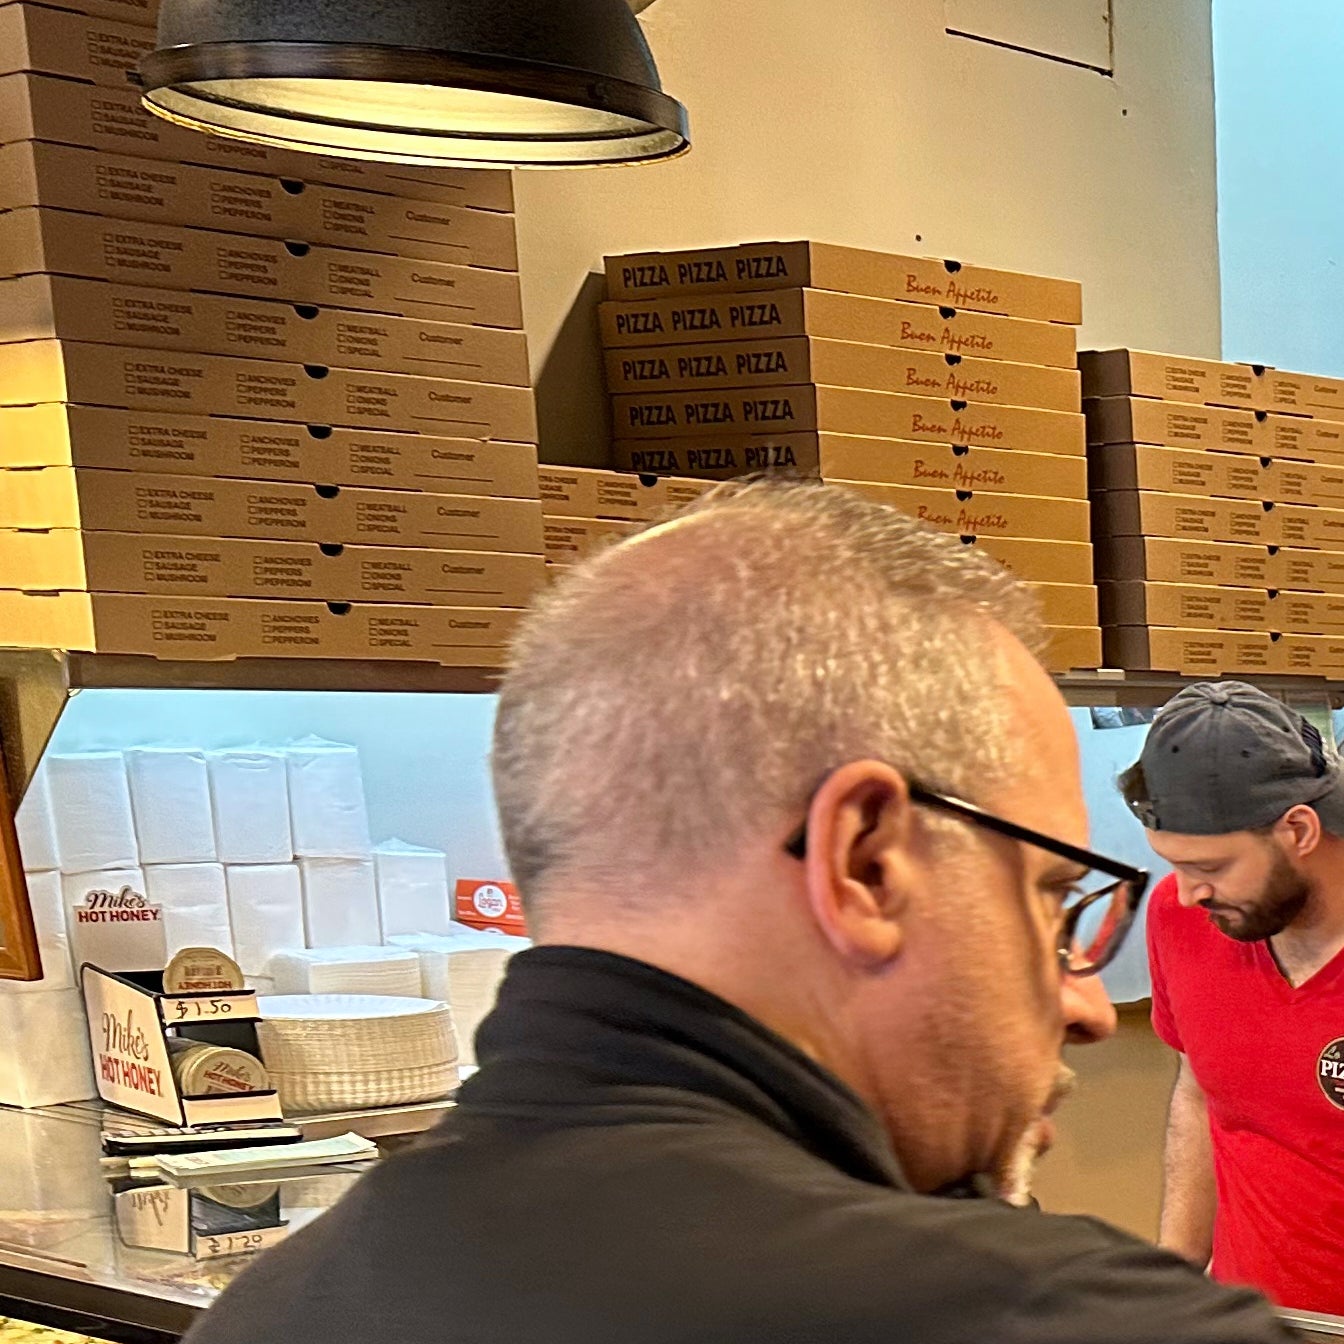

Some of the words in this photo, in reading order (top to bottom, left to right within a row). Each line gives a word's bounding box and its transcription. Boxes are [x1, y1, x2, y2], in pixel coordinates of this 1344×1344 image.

[623, 265, 670, 288] PIZZA
[678, 261, 728, 284] PIZZA
[736, 256, 788, 279] PIZZA
[906, 275, 941, 295] Buon
[946, 281, 998, 305] Appetito
[616, 312, 664, 333] PIZZA
[672, 308, 721, 331] PIZZA
[729, 303, 781, 327] PIZZA
[419, 332, 463, 345] Customer
[901, 322, 936, 342] Buon
[940, 327, 993, 351] Appetito
[622, 359, 670, 380] PIZZA
[677, 355, 728, 378] PIZZA
[736, 352, 787, 374] PIZZA
[906, 368, 941, 387] Buon
[946, 373, 998, 397] Appetito
[429, 392, 471, 404] Customer
[630, 405, 676, 426] PIZZA
[685, 402, 734, 424] PIZZA
[743, 399, 794, 421] PIZZA
[912, 414, 947, 432] Buon
[951, 418, 1003, 441] Appetito
[431, 450, 475, 461] Customer
[631, 450, 679, 471] PIZZA
[687, 449, 737, 469] PIZZA
[745, 446, 796, 466] PIZZA
[913, 460, 949, 478] Buon
[954, 463, 1005, 486] Appetito
[437, 506, 480, 518] Customer
[957, 509, 1008, 530] Appetito
[442, 564, 485, 575] Customer
[449, 620, 491, 630] Customer
[88, 888, 145, 910] Mike's
[78, 910, 108, 922] HOT
[110, 910, 158, 922] HONEY
[176, 1000, 231, 1019] $1.50
[103, 1009, 149, 1061] Mike's
[100, 1053, 120, 1083] HOT
[122, 1061, 162, 1097] HONEY
